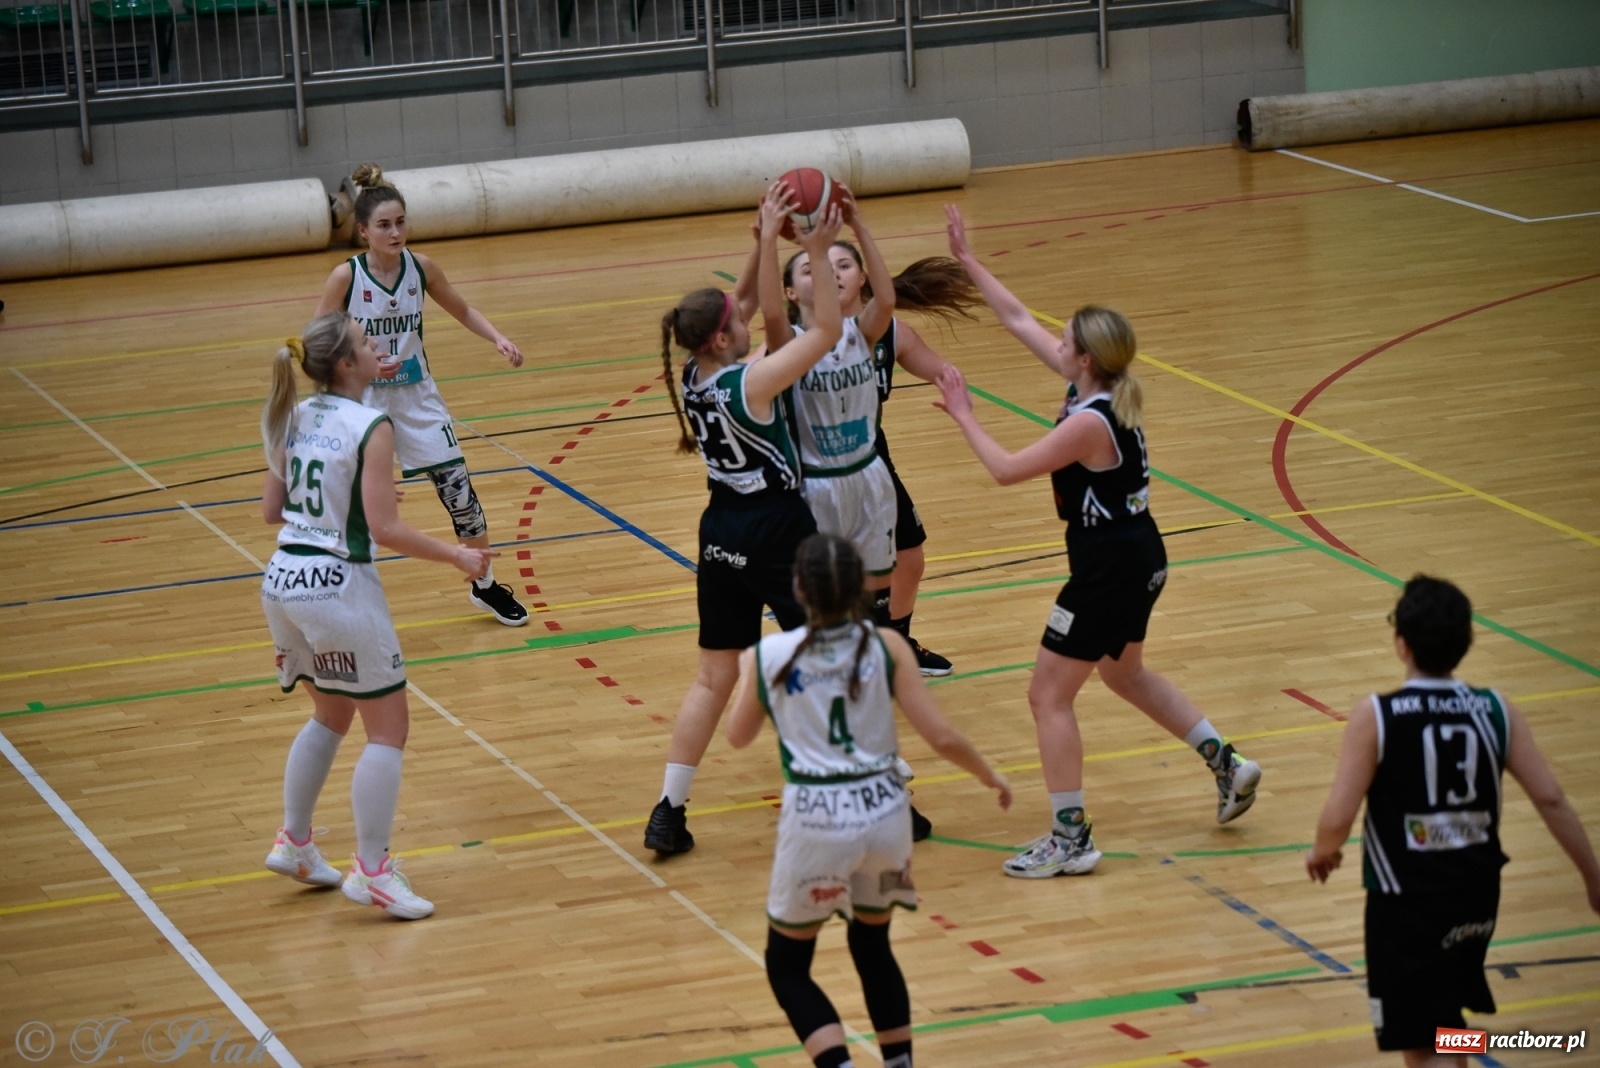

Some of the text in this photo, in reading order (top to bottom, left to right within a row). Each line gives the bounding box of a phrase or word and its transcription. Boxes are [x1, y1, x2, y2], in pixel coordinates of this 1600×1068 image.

[390, 338, 399, 355] 11
[441, 423, 458, 448] 11
[687, 407, 747, 470] 23
[284, 455, 325, 518] 25
[828, 695, 854, 754] 4
[1422, 723, 1479, 808] 13
